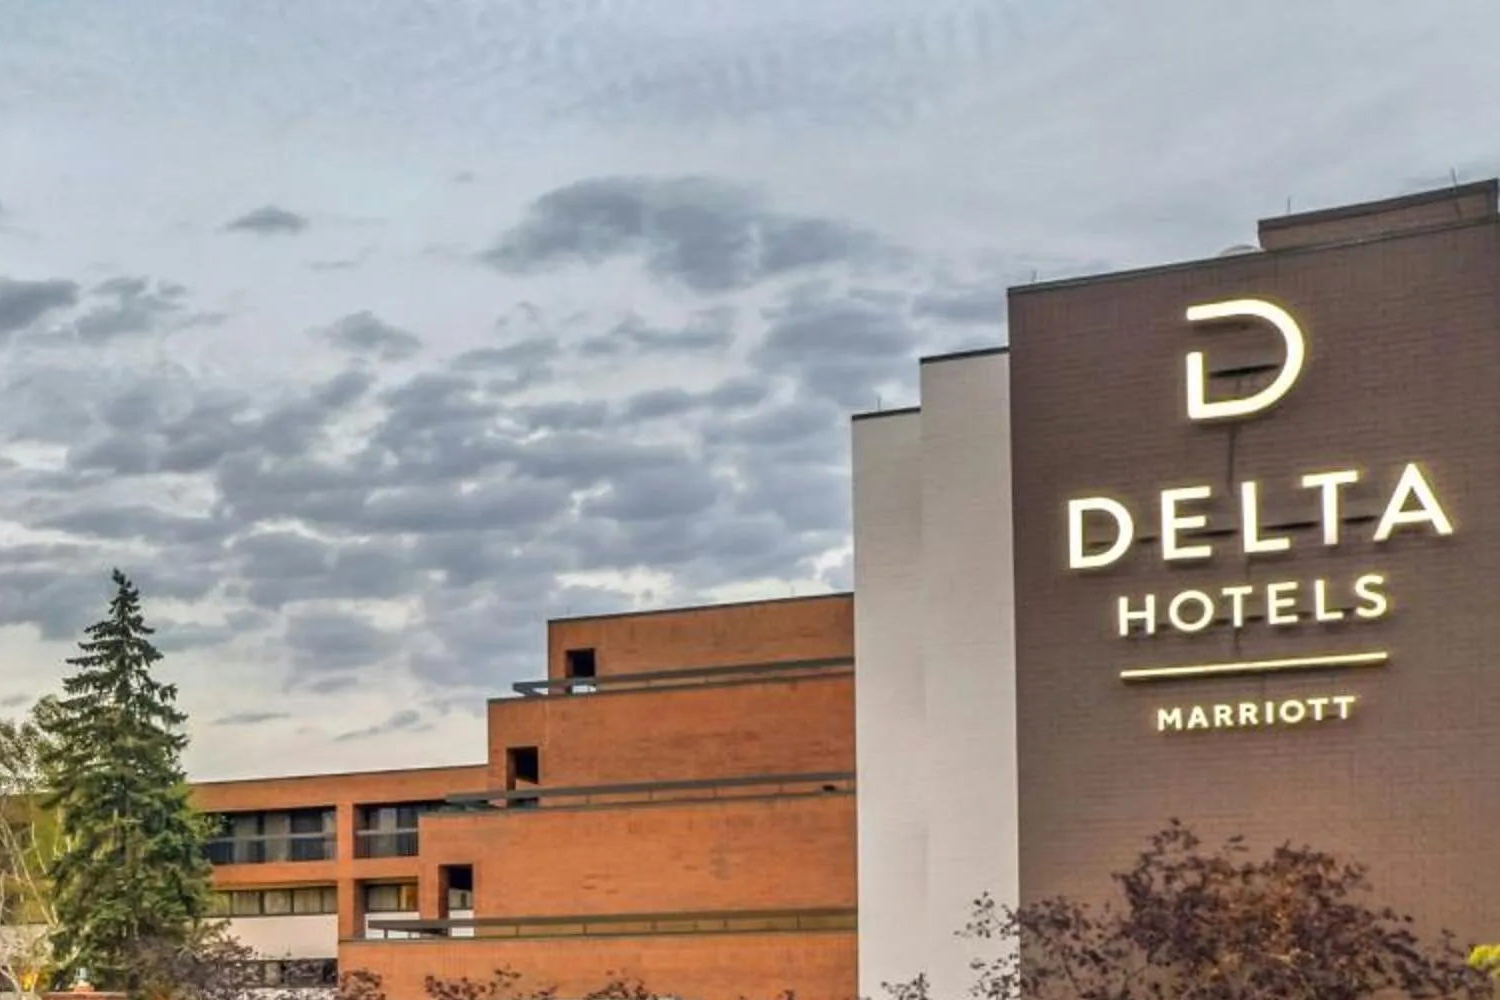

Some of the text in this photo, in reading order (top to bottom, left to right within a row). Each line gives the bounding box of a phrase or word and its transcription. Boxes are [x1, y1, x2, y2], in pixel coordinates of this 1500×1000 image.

[1068, 463, 1454, 569] DELTA
[1118, 574, 1388, 637] HOTELS
[1157, 696, 1357, 731] MARRIOTT
